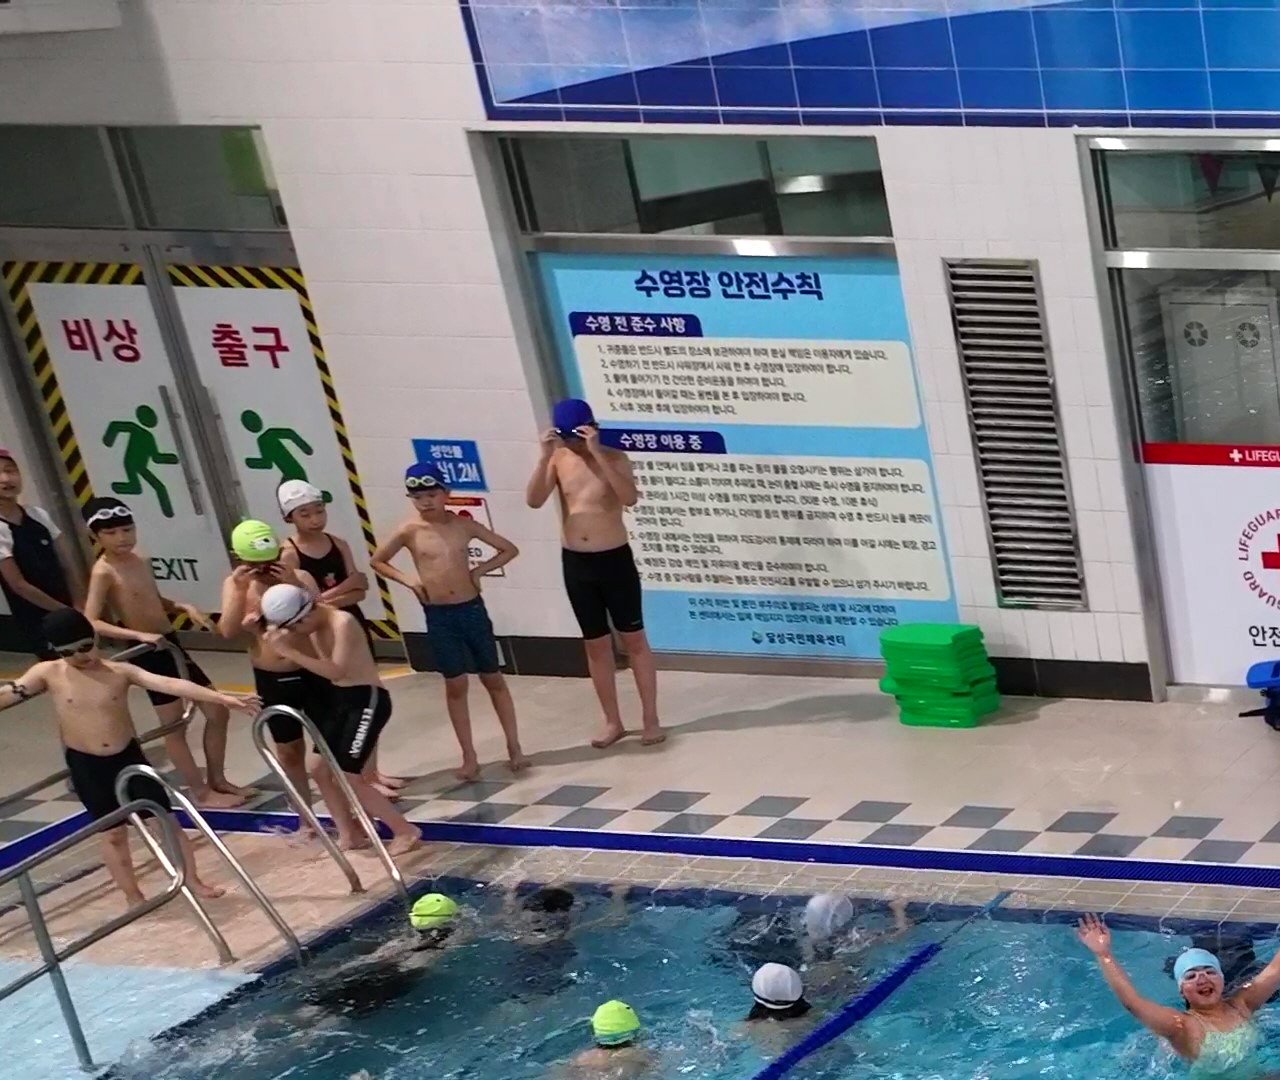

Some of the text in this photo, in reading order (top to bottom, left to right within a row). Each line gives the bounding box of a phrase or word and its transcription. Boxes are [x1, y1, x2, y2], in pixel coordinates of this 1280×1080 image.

[634, 269, 825, 301] 수영장 안전수칙
[585, 315, 687, 334] 수영 전 준수 사항
[61, 318, 291, 369] 비상 출구
[619, 433, 703, 450] 수영장 이용 중
[150, 557, 199, 581] EXIT
[765, 632, 847, 646] 달성국민체육센터
